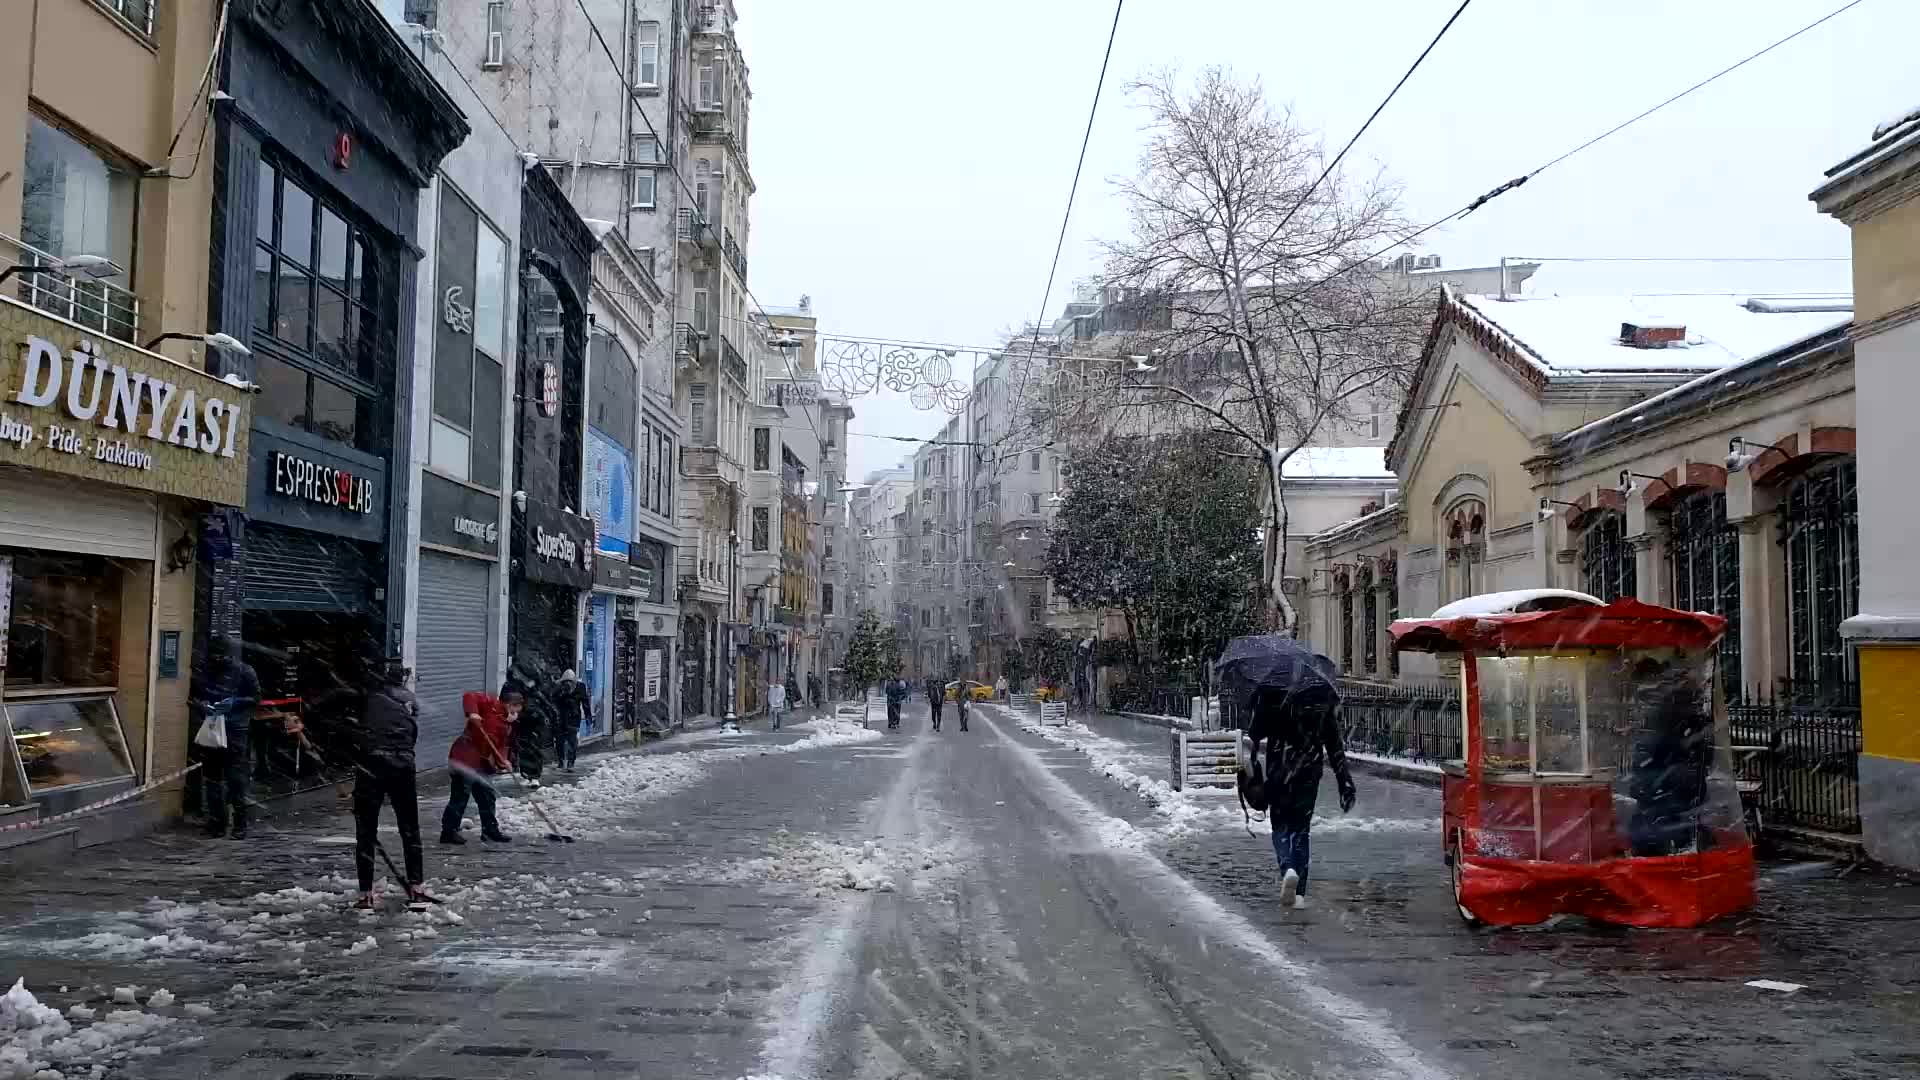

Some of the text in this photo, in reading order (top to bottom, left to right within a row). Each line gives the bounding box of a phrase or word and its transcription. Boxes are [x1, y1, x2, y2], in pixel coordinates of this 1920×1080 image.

[16, 334, 241, 459] DÜNYASI
[47, 424, 82, 455] Pide
[95, 437, 152, 470] Baklava
[536, 525, 576, 569] SuperStep
[627, 645, 635, 704] CHANGE
